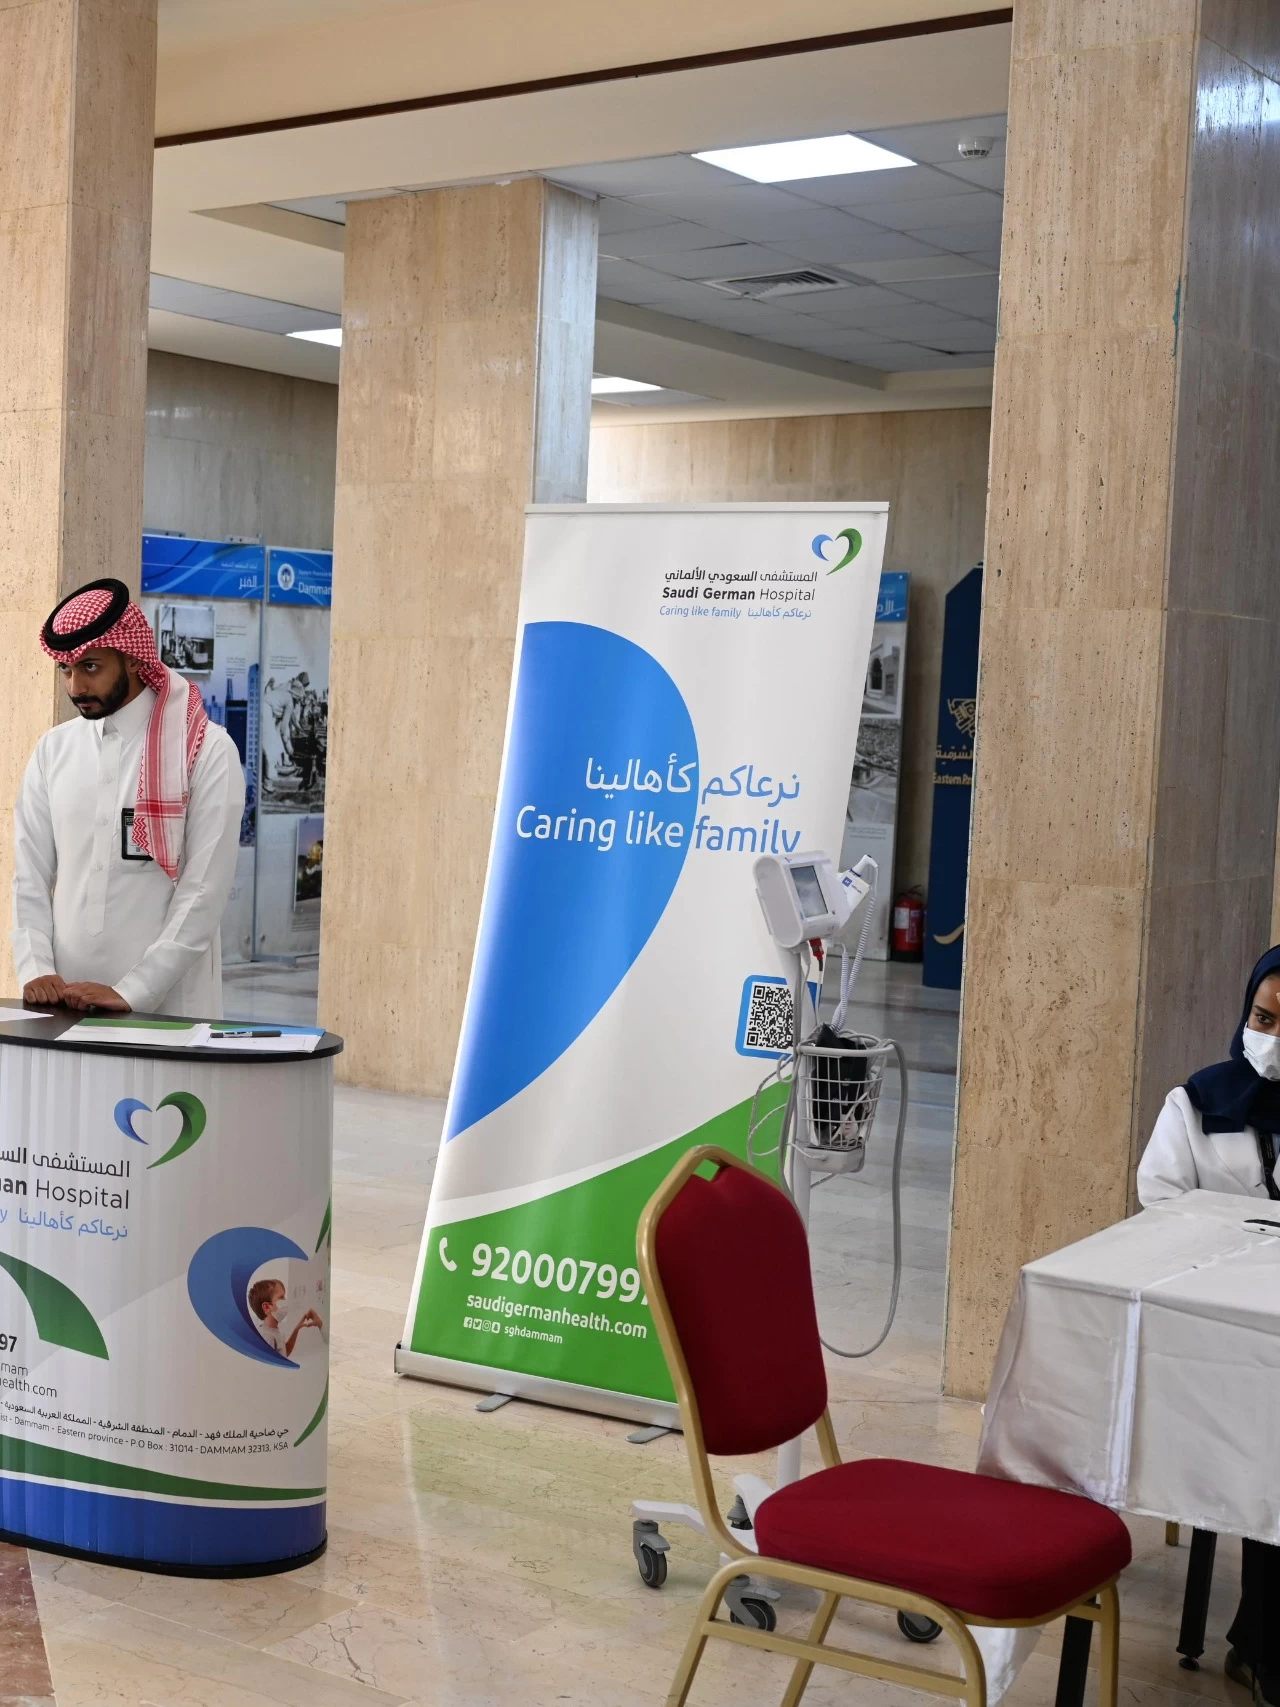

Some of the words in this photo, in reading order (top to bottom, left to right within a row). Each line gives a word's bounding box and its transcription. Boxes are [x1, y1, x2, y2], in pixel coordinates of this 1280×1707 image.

[664, 566, 706, 582] الألماني
[708, 570, 758, 584] السعودي
[760, 570, 818, 582] المستشفى
[662, 587, 699, 599] Saudi
[702, 587, 756, 600] German
[759, 588, 816, 602] Hospital
[659, 605, 689, 618] Caring
[691, 606, 709, 617] like
[711, 606, 742, 620] family
[747, 605, 782, 620] كأهالينا
[782, 607, 812, 620] نرعاكم
[936, 744, 973, 766] لشرقية
[585, 753, 696, 800] كأهالينا
[701, 764, 800, 808] نرعاكم
[516, 805, 616, 852] Caring
[625, 810, 684, 848] like
[694, 815, 801, 855] family
[32, 1152, 130, 1178] المستشفى
[36, 1178, 130, 1210] Hospital
[18, 1208, 74, 1231] كأهالينا
[78, 1220, 128, 1241] نرعاكم
[466, 1294, 648, 1339] saudigermanhealth.com
[504, 1324, 564, 1344] sghdammam
[4, 1402, 36, 1414] السعودية
[37, 1408, 62, 1420] العربية
[62, 1412, 92, 1426] المملكة
[98, 1419, 129, 1432] الشرقية
[14, 1417, 50, 1432] Dammam
[58, 1426, 86, 1439] Eastern
[88, 1433, 124, 1445] province
[148, 1441, 163, 1450] Box
[170, 1444, 194, 1453] 31014
[200, 1446, 246, 1454] DAMMAM
[273, 1441, 289, 1451] KSA
[131, 1422, 165, 1436] المنطقة
[172, 1428, 198, 1439] الدمام
[204, 1429, 220, 1440] فهد
[222, 1428, 248, 1439] الملك
[249, 1428, 276, 1438] ضاحية
[276, 1428, 289, 1438] حي
